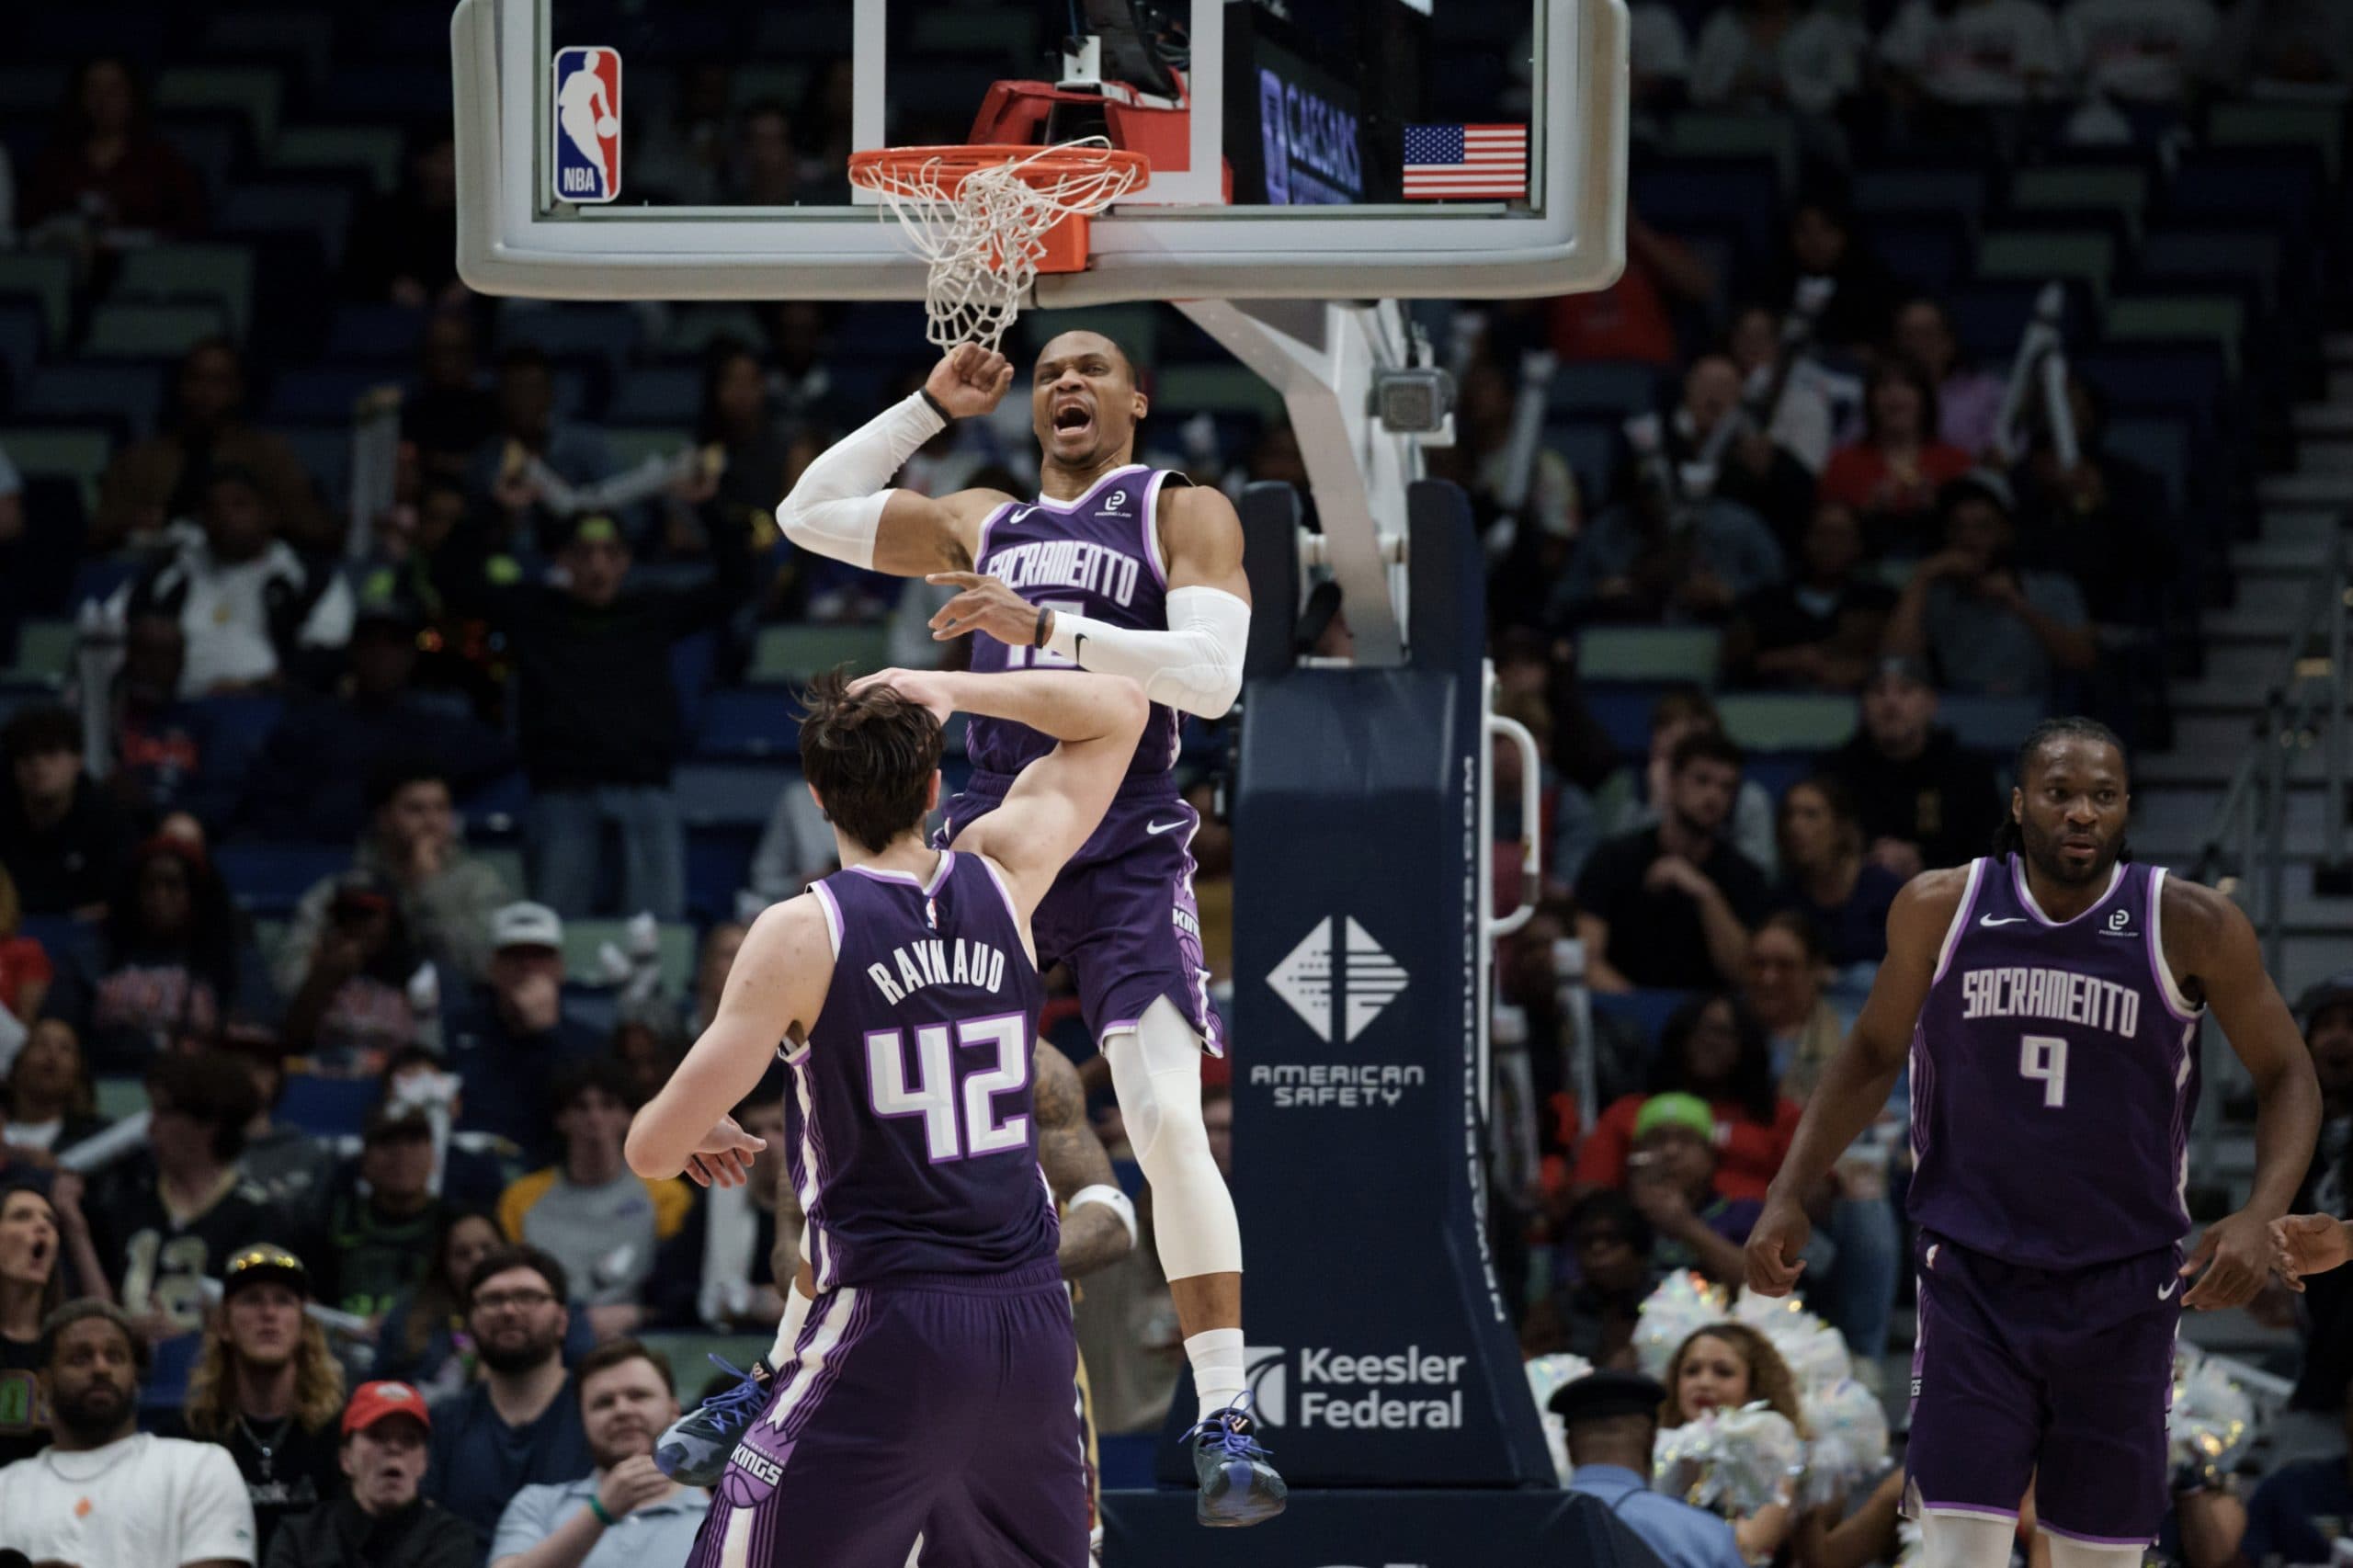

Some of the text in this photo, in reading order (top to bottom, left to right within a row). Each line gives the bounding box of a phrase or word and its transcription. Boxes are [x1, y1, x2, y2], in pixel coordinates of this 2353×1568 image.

[563, 166, 596, 193] NBA
[986, 540, 1140, 608] SACRAMENTO
[1172, 908, 1201, 941] KIN
[867, 938, 1006, 1006] RAYNAUD
[1962, 968, 2140, 1039] SACRAMENTO
[863, 1010, 1029, 1165] 42
[1251, 1065, 1426, 1086] AMERICAN
[2019, 1035, 2068, 1108] 9
[1272, 1086, 1403, 1108] SAFETY
[1300, 1345, 1467, 1385] Keesler
[1300, 1389, 1462, 1429] Federal
[730, 1442, 784, 1486] KINGS
